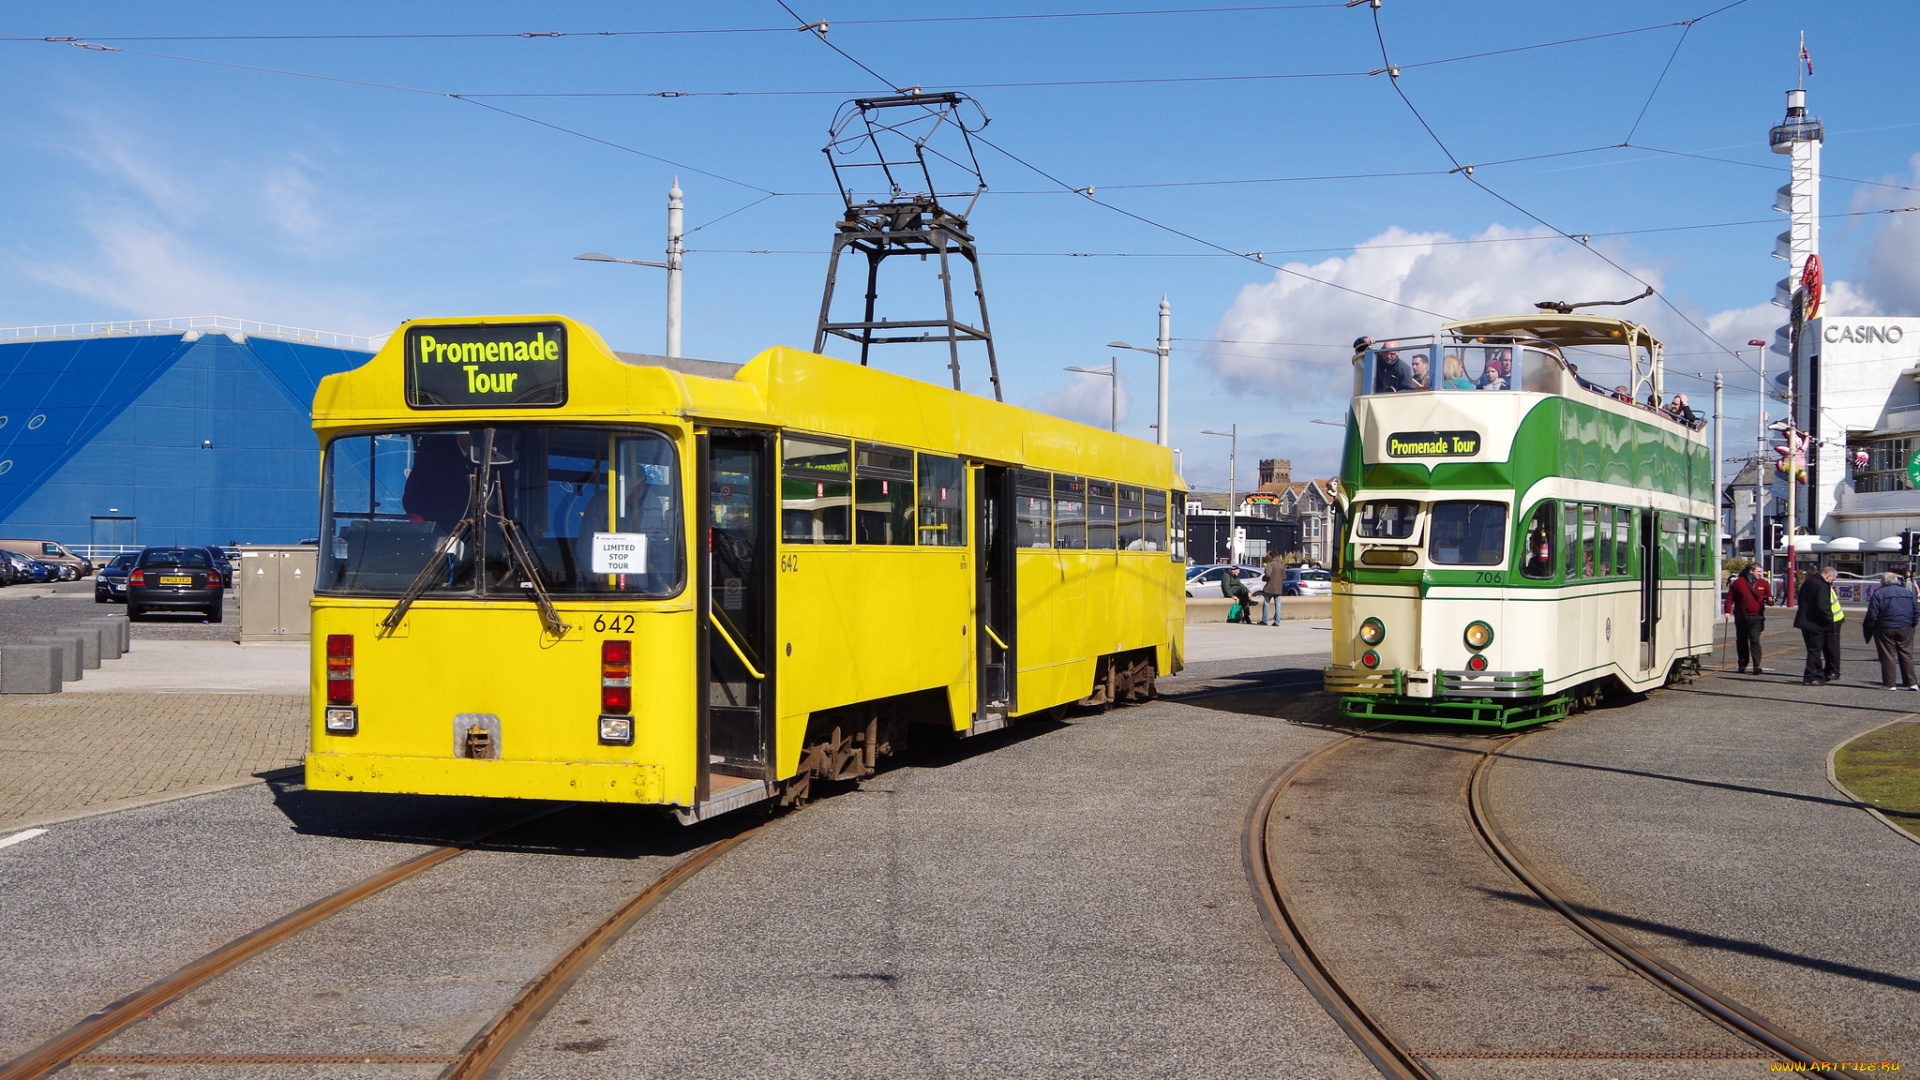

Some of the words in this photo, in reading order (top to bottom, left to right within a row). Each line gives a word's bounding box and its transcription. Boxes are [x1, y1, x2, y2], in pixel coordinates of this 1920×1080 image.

[1824, 325, 1904, 344] CASINO
[420, 332, 559, 363] Promenade
[463, 365, 518, 393] Tour
[1391, 437, 1448, 455] Promenade
[1453, 436, 1476, 453] Tour
[781, 555, 798, 572] 642
[1475, 572, 1502, 583] 706
[593, 614, 635, 634] 642
